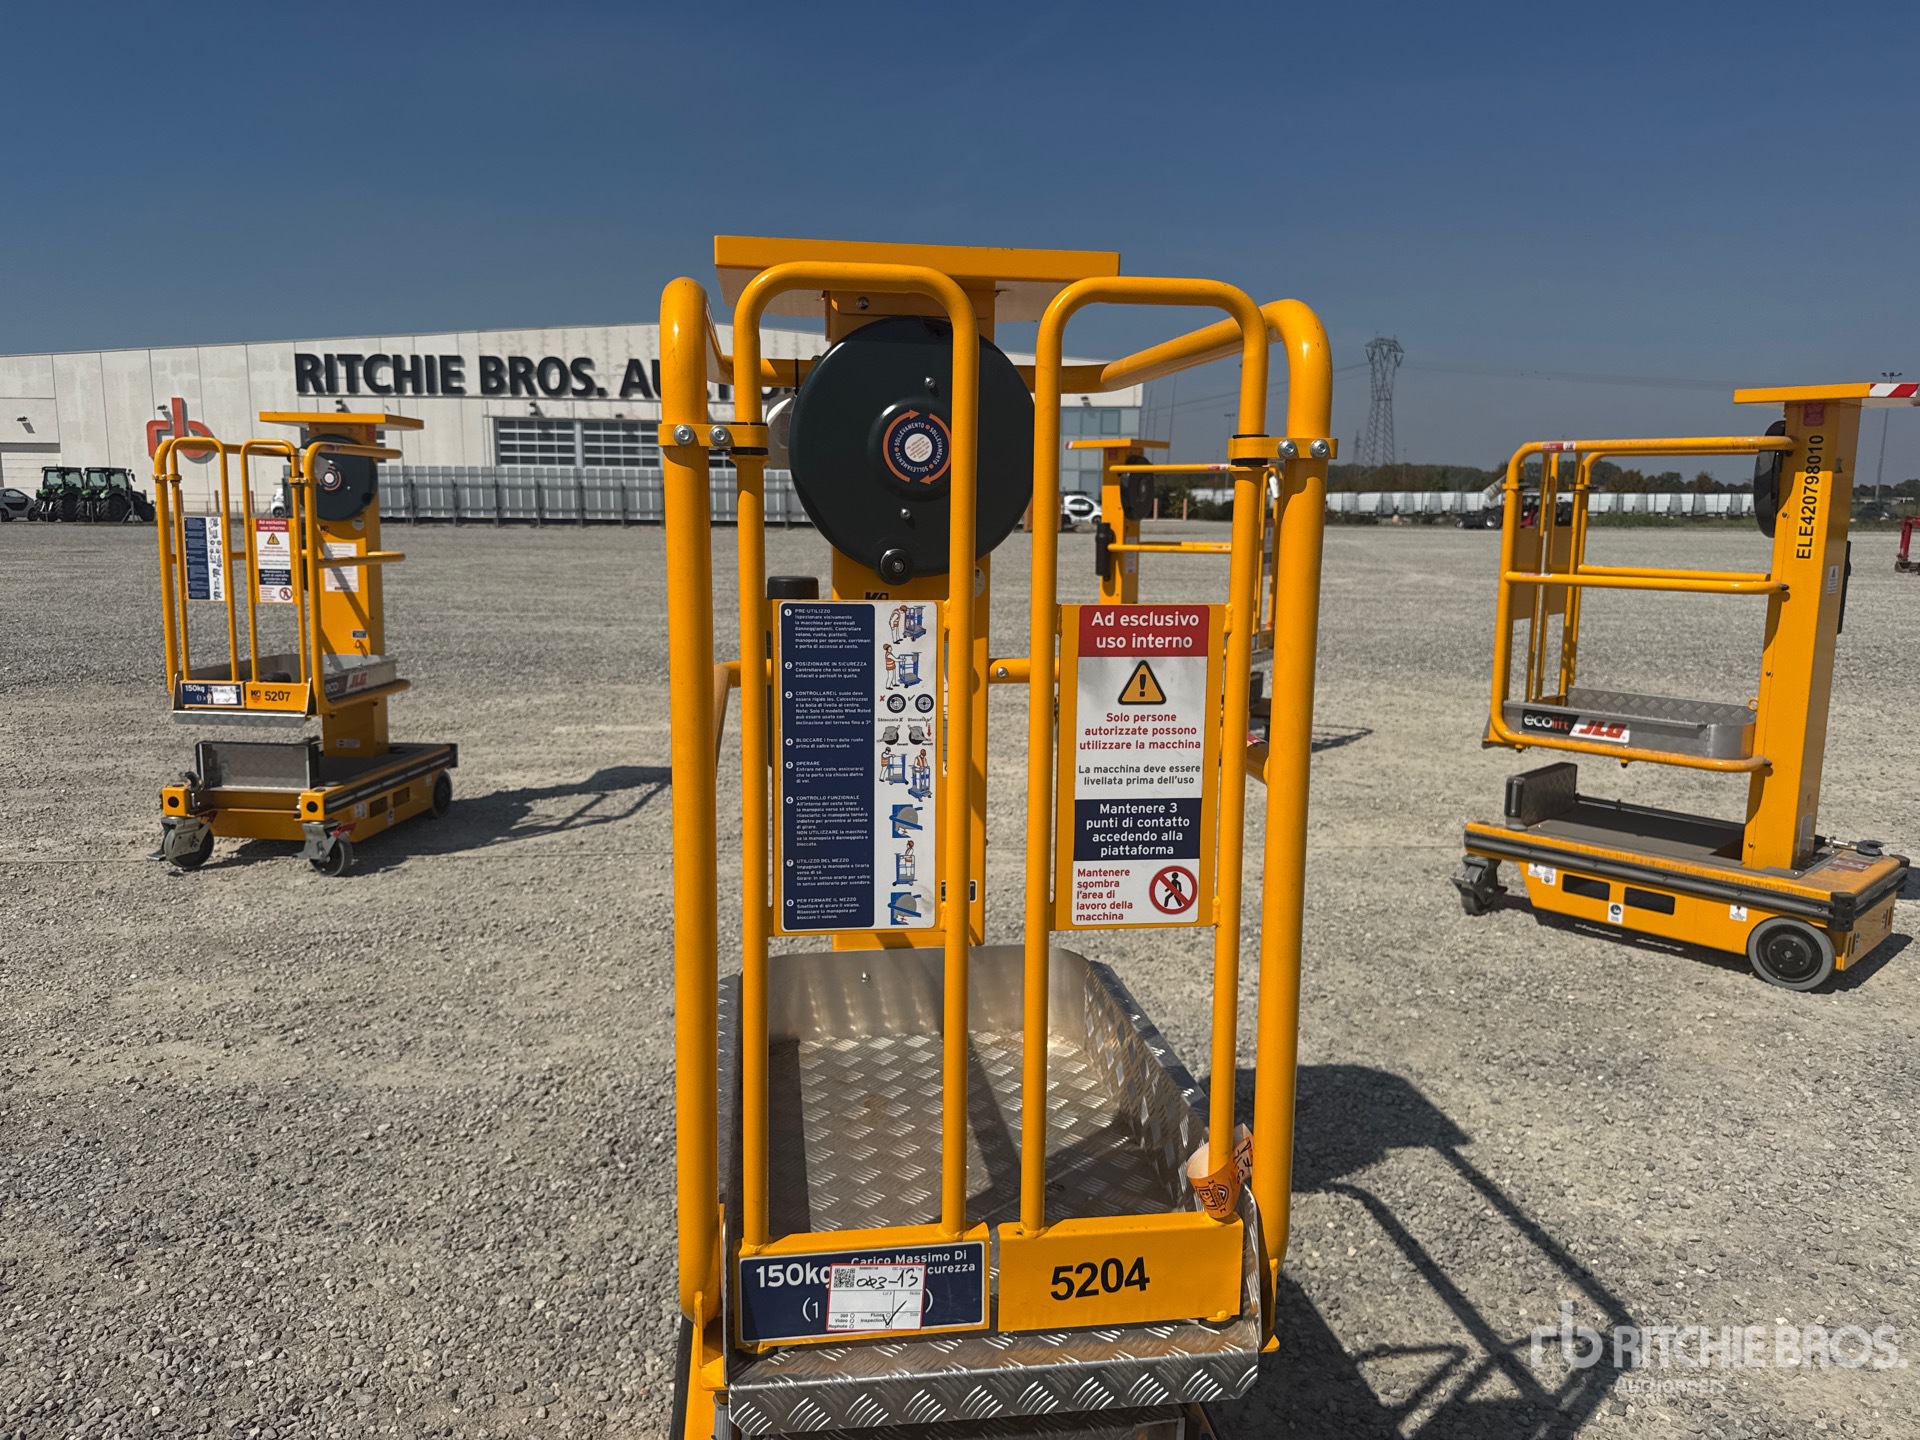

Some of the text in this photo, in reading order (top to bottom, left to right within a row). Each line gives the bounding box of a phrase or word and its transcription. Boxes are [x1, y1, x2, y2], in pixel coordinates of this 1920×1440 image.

[295, 354, 465, 395] RITCHIE
[479, 355, 606, 396] BROS.
[894, 422, 925, 446] SOLLEVAMENTO
[929, 427, 943, 465] SOLLEVAMENTO
[895, 453, 928, 473] SOLLEVAMENTO
[1796, 435, 1824, 559] ELE420798010
[1091, 611, 1199, 626] Ad esclusivo
[1096, 634, 1193, 648] uso interno
[349, 673, 367, 688] JLG
[185, 685, 205, 693] 150kg
[265, 691, 291, 701] 5207
[1106, 712, 1177, 724] Solo persone
[1085, 726, 1197, 737] autorizzate possono
[1579, 720, 1627, 738] JLG
[1080, 740, 1200, 750] utilizzare la macchina
[1078, 765, 1090, 774] La
[1094, 764, 1140, 774] macchina
[1144, 764, 1166, 773] deve
[1084, 775, 1194, 786] livellata prima dell'uso
[1100, 802, 1178, 814] Mantenere 3
[1086, 817, 1190, 830] punti di contatto
[1092, 831, 1183, 842] accedendo alla
[1100, 844, 1174, 858] piattaforma
[1078, 868, 1130, 877] Mantenere
[1077, 879, 1120, 890] sgombra
[1077, 890, 1115, 899] l'area di
[1076, 901, 1133, 910] lavoro della
[1076, 912, 1124, 921] macchina
[895, 1253, 950, 1264] Massimo
[954, 1250, 967, 1261] Di
[1050, 1256, 1150, 1301] 5204
